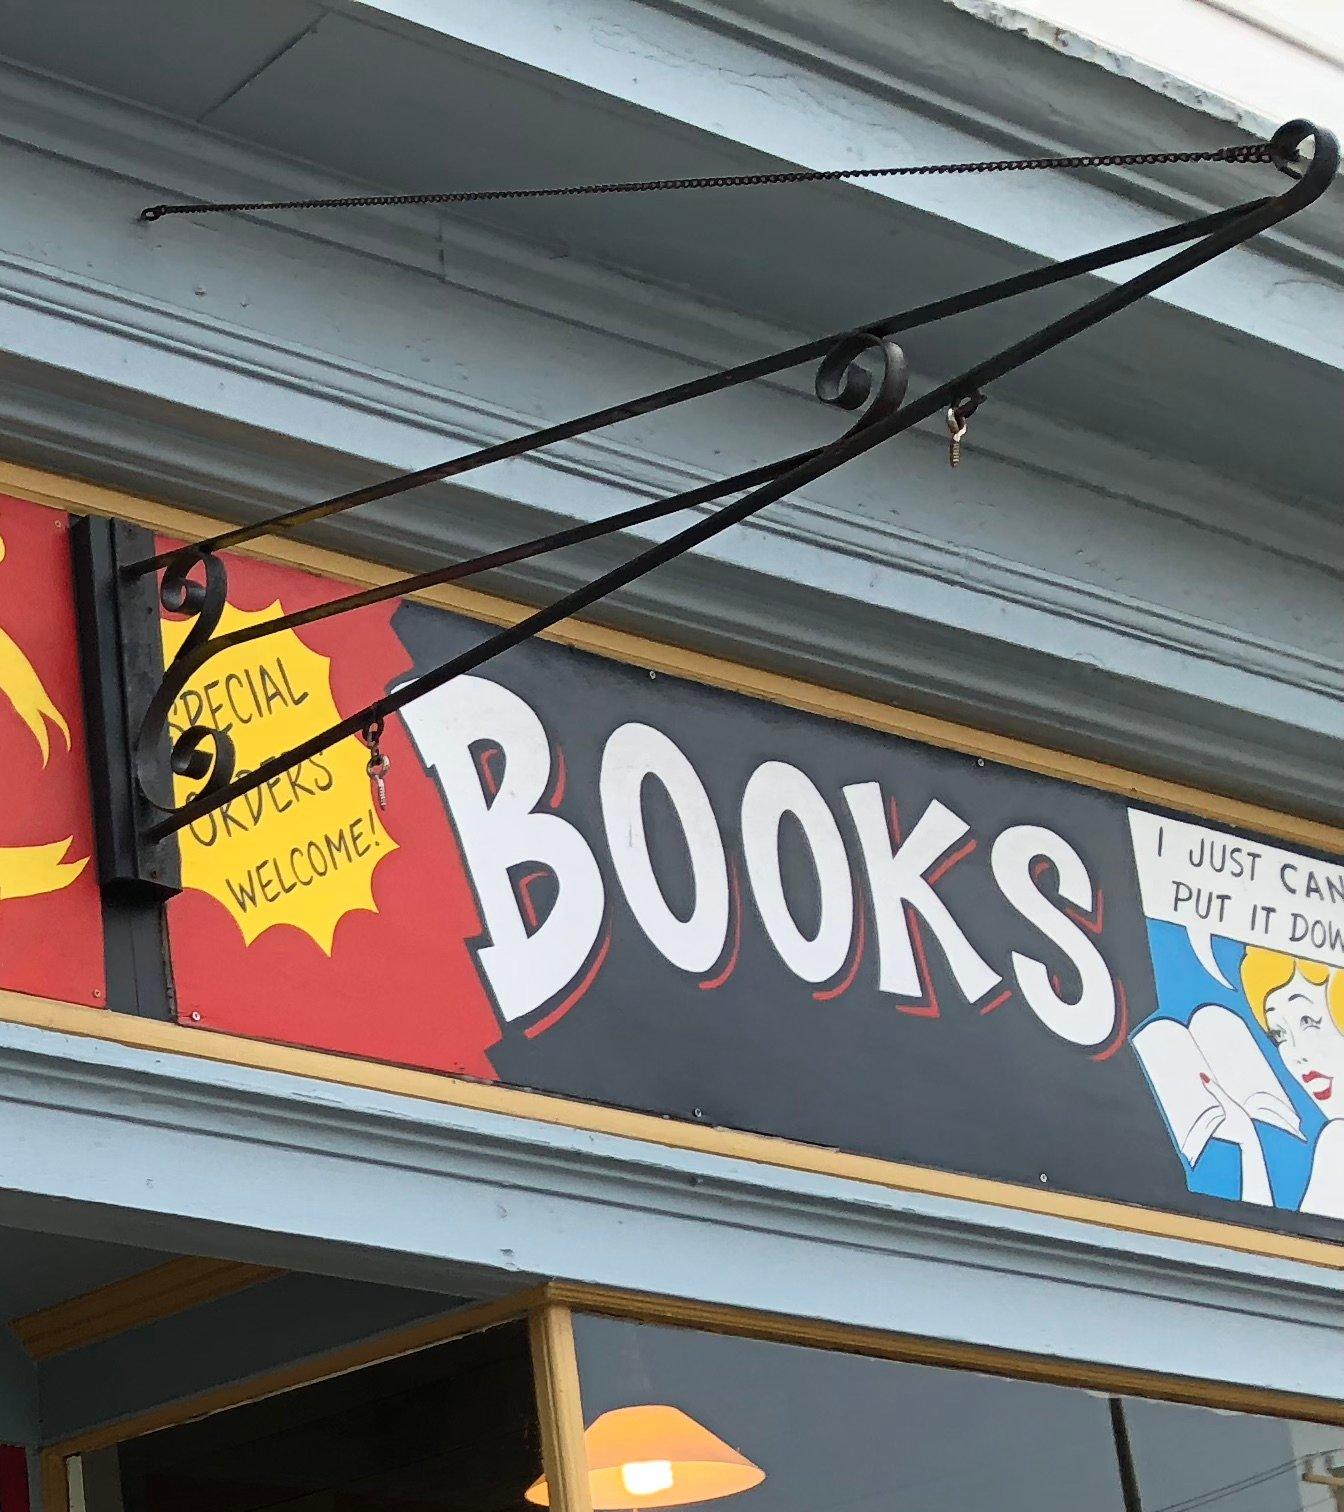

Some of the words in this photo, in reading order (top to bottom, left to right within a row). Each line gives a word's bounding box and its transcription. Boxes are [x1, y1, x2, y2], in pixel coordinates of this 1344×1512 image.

[169, 657, 309, 734] SPECIAL
[225, 809, 380, 913] WELCOME!
[394, 673, 1118, 1047] BOOKS
[1158, 826, 1164, 857] I
[1189, 838, 1262, 881] JUST
[1172, 880, 1232, 923] PUT
[1250, 904, 1277, 935] IT
